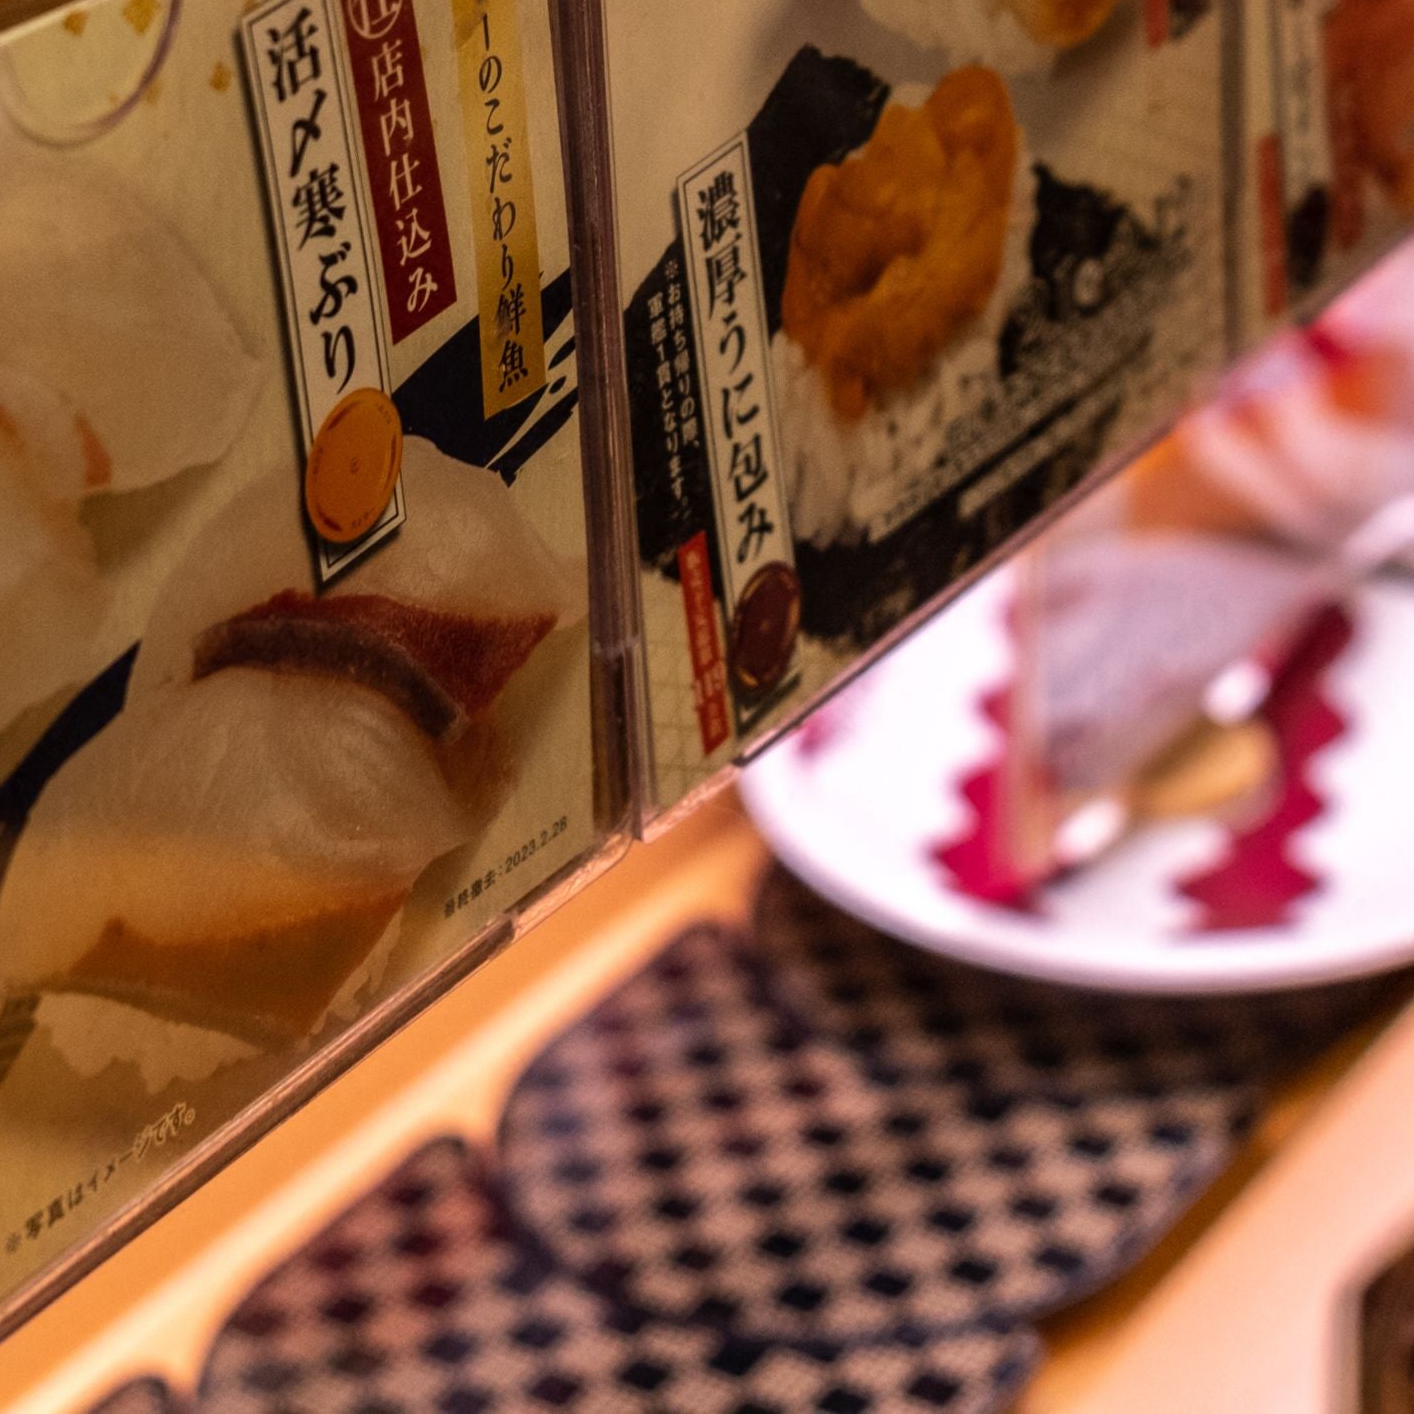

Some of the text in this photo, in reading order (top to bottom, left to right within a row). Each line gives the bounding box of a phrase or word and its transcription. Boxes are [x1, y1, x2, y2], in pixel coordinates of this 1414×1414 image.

[696, 170, 774, 564] 濃厚うに包み
